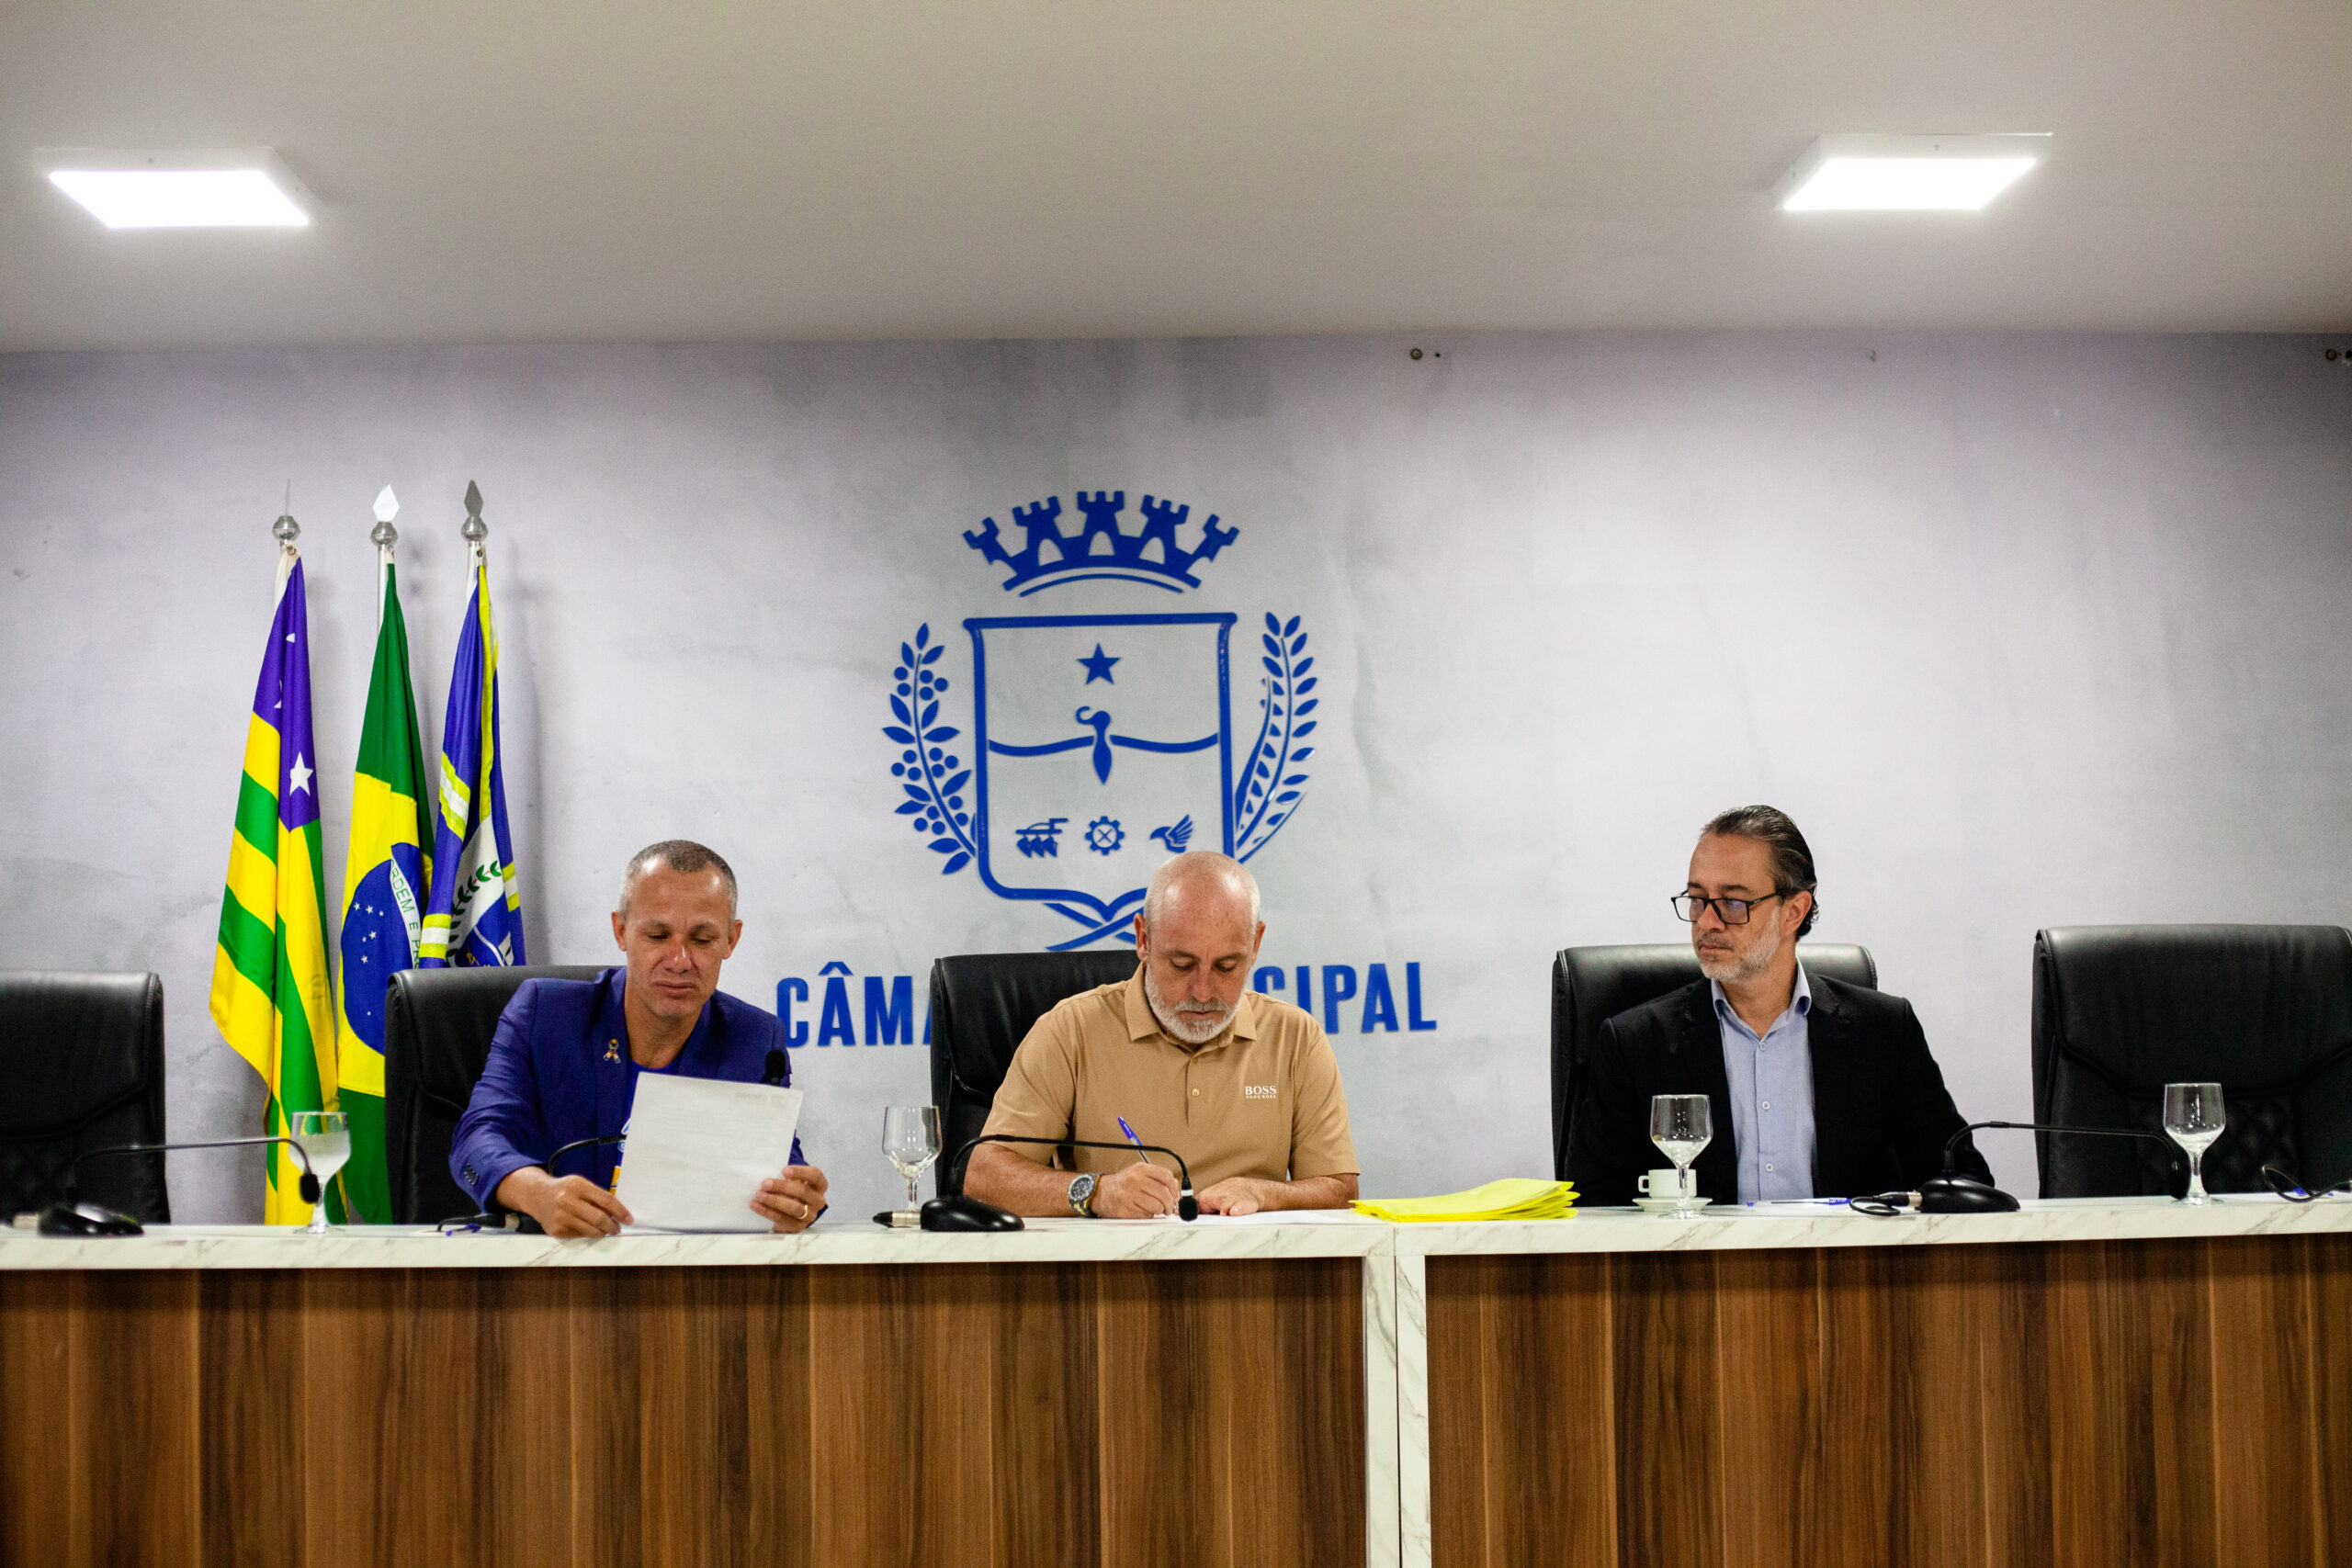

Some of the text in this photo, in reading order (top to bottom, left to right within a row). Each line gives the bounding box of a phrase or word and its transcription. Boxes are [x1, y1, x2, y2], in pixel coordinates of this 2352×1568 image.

[409, 921, 418, 931] E
[776, 961, 931, 1048] CÂM
[1244, 1085, 1277, 1096] BOSS
